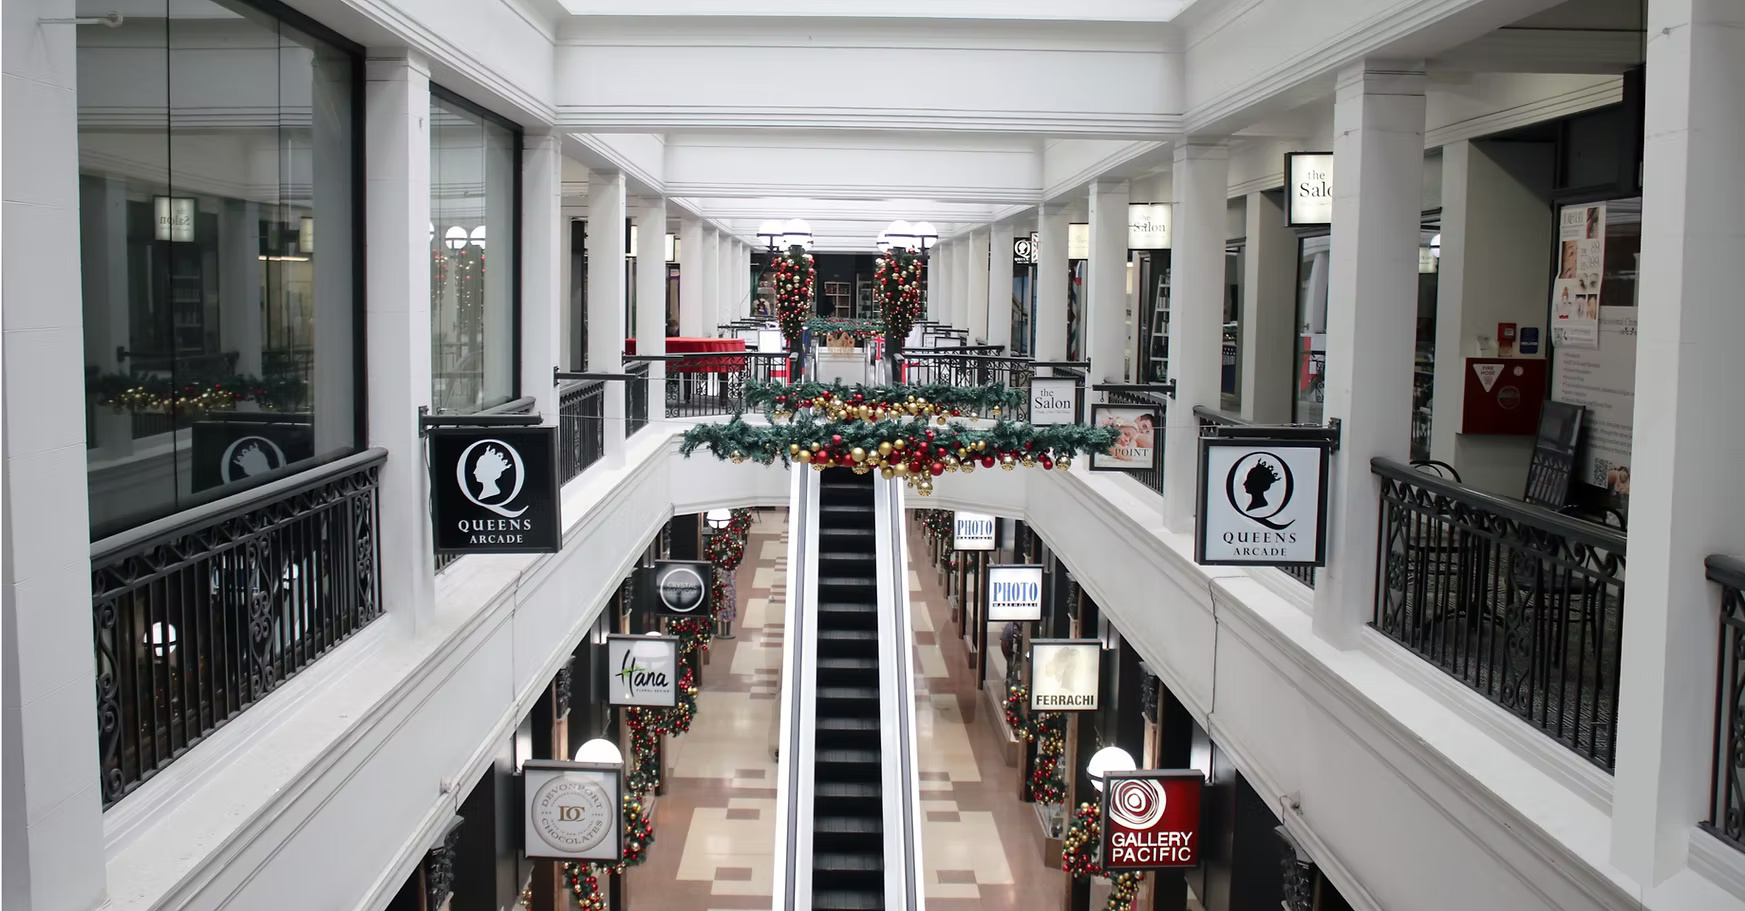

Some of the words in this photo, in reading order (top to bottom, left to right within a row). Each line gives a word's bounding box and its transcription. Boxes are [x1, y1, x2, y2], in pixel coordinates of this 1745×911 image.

[1308, 169, 1325, 180] the
[1300, 181, 1333, 198] Salo
[1133, 221, 1166, 232] Salon
[1040, 388, 1054, 397] the
[1034, 396, 1071, 409] Salon
[1114, 447, 1149, 457] POINT
[458, 519, 532, 533] QUEENS
[957, 519, 993, 536] PHOTO
[469, 534, 523, 544] ARCADE
[1223, 531, 1297, 544] QUEENS
[1233, 547, 1287, 556] ARCADE
[993, 582, 1038, 602] PHOTO
[615, 649, 669, 697] Hana
[1036, 694, 1094, 706] FERRACHI
[541, 783, 603, 809] DEVONPORT
[541, 818, 603, 845] CHOCOLATES
[1111, 831, 1193, 847] GALLERY
[1112, 847, 1191, 862] PACIFIC
